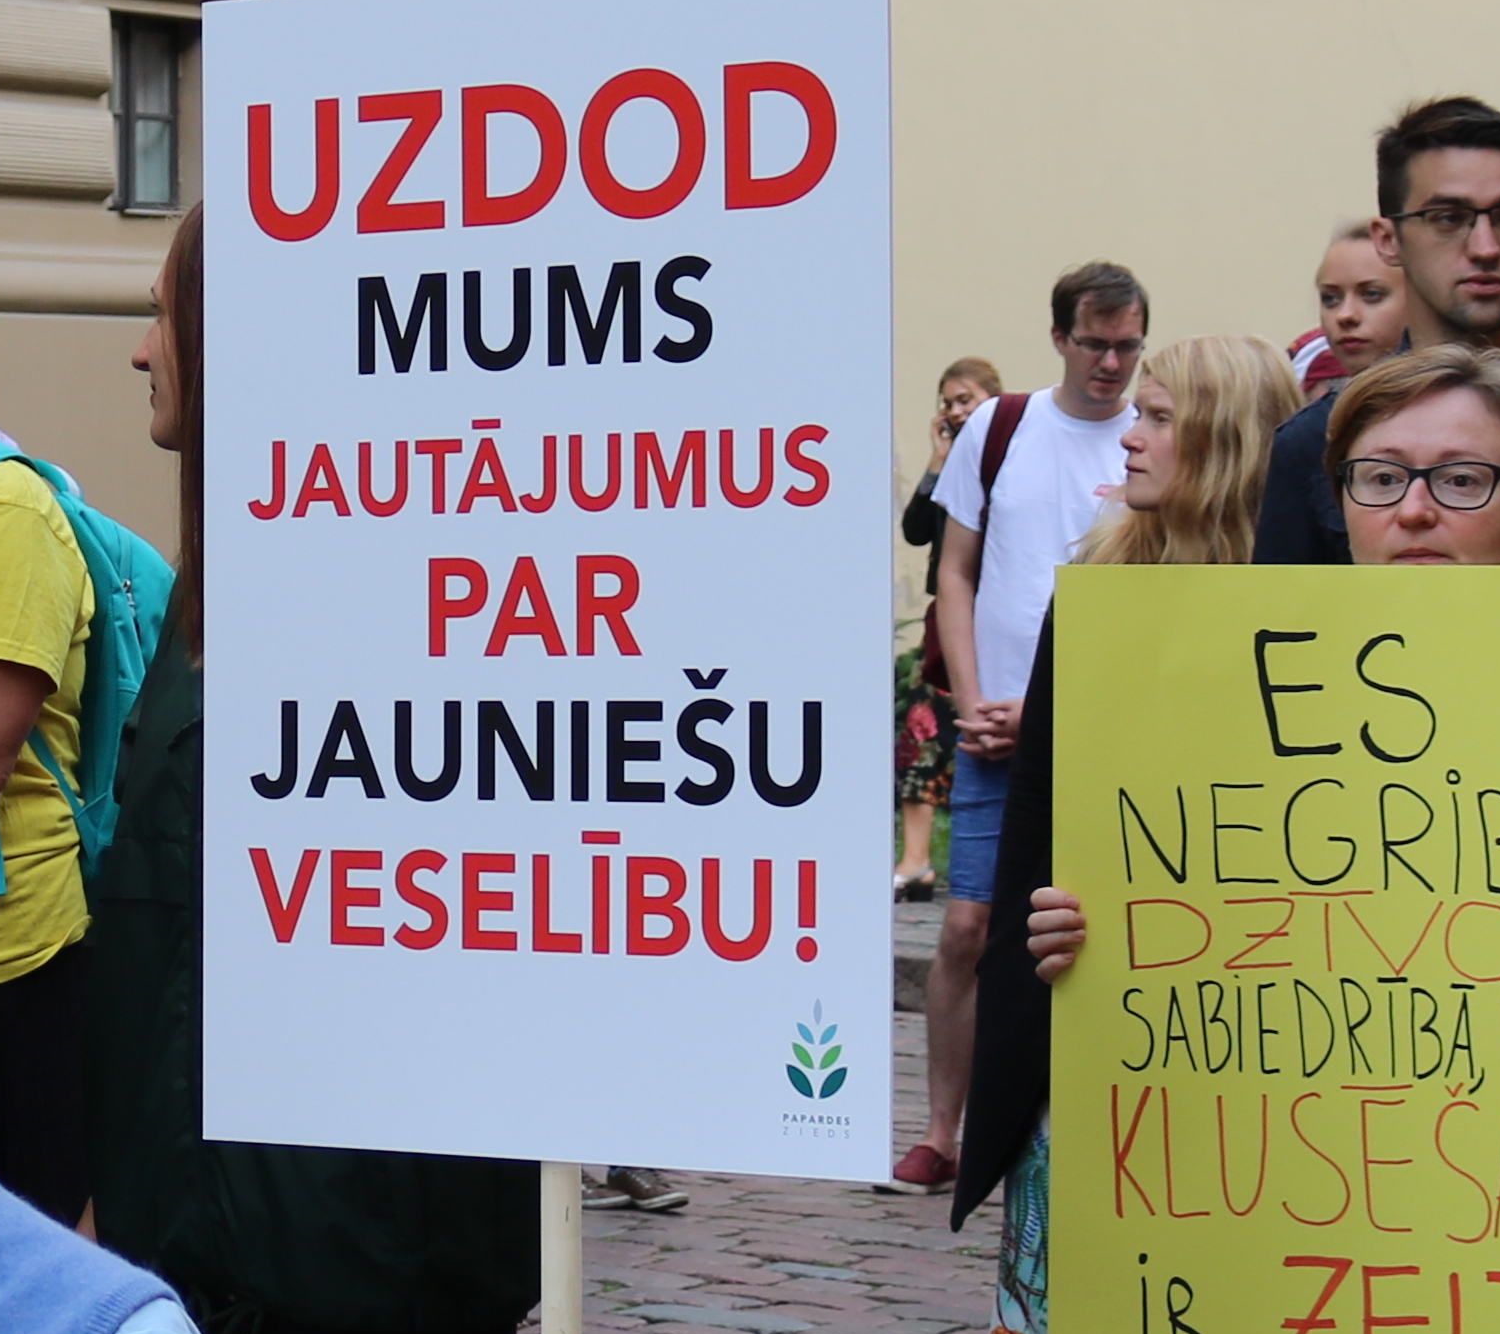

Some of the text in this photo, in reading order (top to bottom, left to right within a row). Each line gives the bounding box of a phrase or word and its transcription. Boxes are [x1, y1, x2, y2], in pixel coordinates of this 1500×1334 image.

[246, 59, 839, 244] UZDOD
[357, 254, 715, 377] MUMS
[247, 418, 832, 522] JAUTĀJUMUS
[427, 554, 644, 659] PAR
[248, 667, 825, 808] JAUNIEŠU
[1255, 629, 1438, 764] ES
[246, 829, 821, 965] VESELĪBU!
[782, 1113, 850, 1126] PAPARDES
[783, 1126, 850, 1139] ZIEDS
